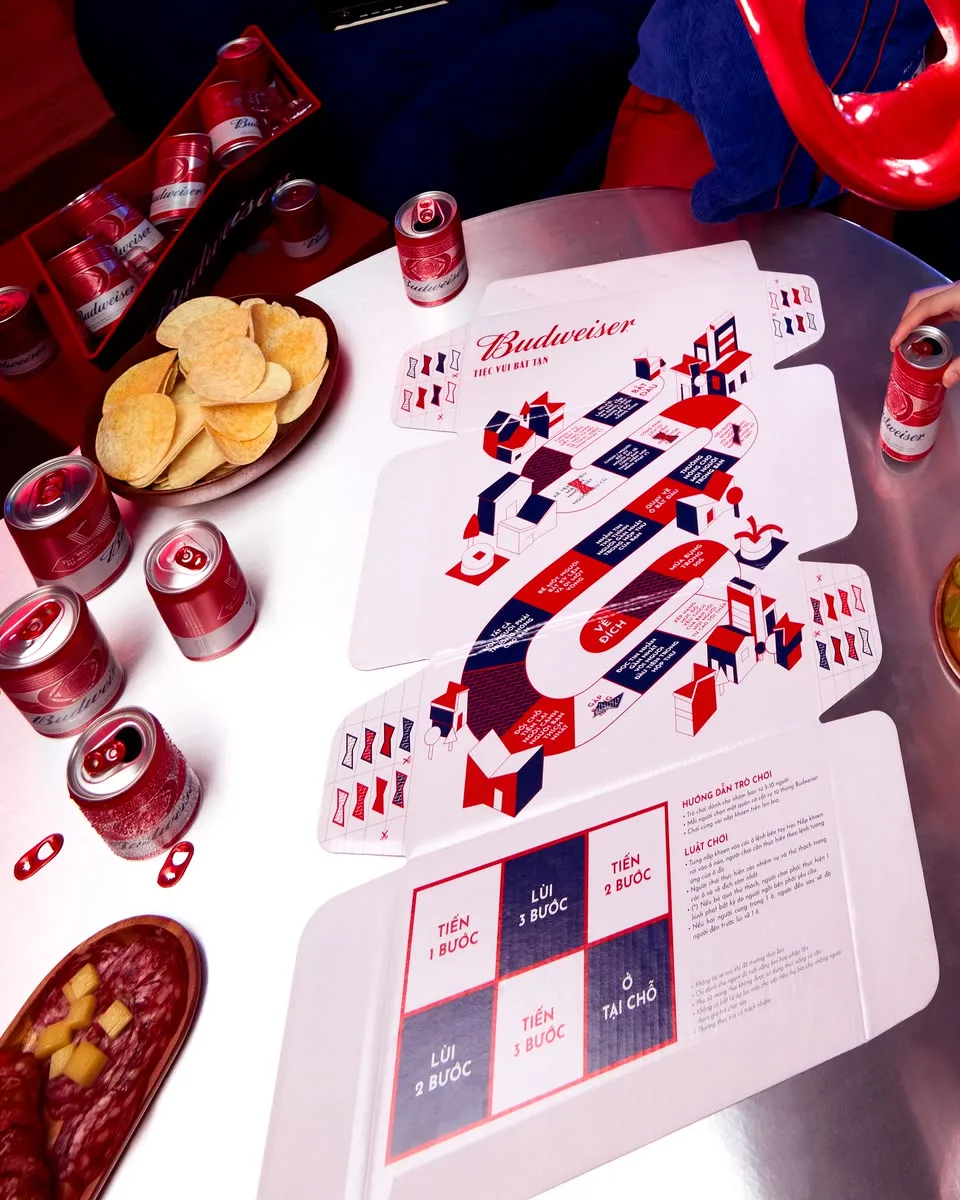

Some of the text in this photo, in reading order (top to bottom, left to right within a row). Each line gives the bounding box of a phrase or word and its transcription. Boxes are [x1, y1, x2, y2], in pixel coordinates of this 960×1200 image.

[476, 318, 637, 362] Budweiser
[496, 362, 511, 373] VUI
[598, 619, 628, 644] ĐÍCH
[682, 770, 772, 808] HƯỚNG DẪN TRÒ CHƠI
[795, 775, 818, 787] Budweiser
[684, 832, 728, 857] LUẬT CHƠI
[611, 851, 641, 875] TIẾN
[531, 883, 553, 904] LÙI
[604, 868, 652, 896] 2 BƯỚC
[437, 912, 470, 938] TIẾN
[518, 897, 568, 927] 3 BƯỚC
[429, 930, 479, 960] 1 BƯỚC
[622, 972, 633, 991] Ở
[602, 979, 657, 1021] TẠI CHỖ
[521, 1004, 555, 1032] TIẾN
[513, 1024, 566, 1057] 3 BƯỚC
[430, 1043, 456, 1068] LÙI
[415, 1059, 472, 1097] 2 BƯỚC
